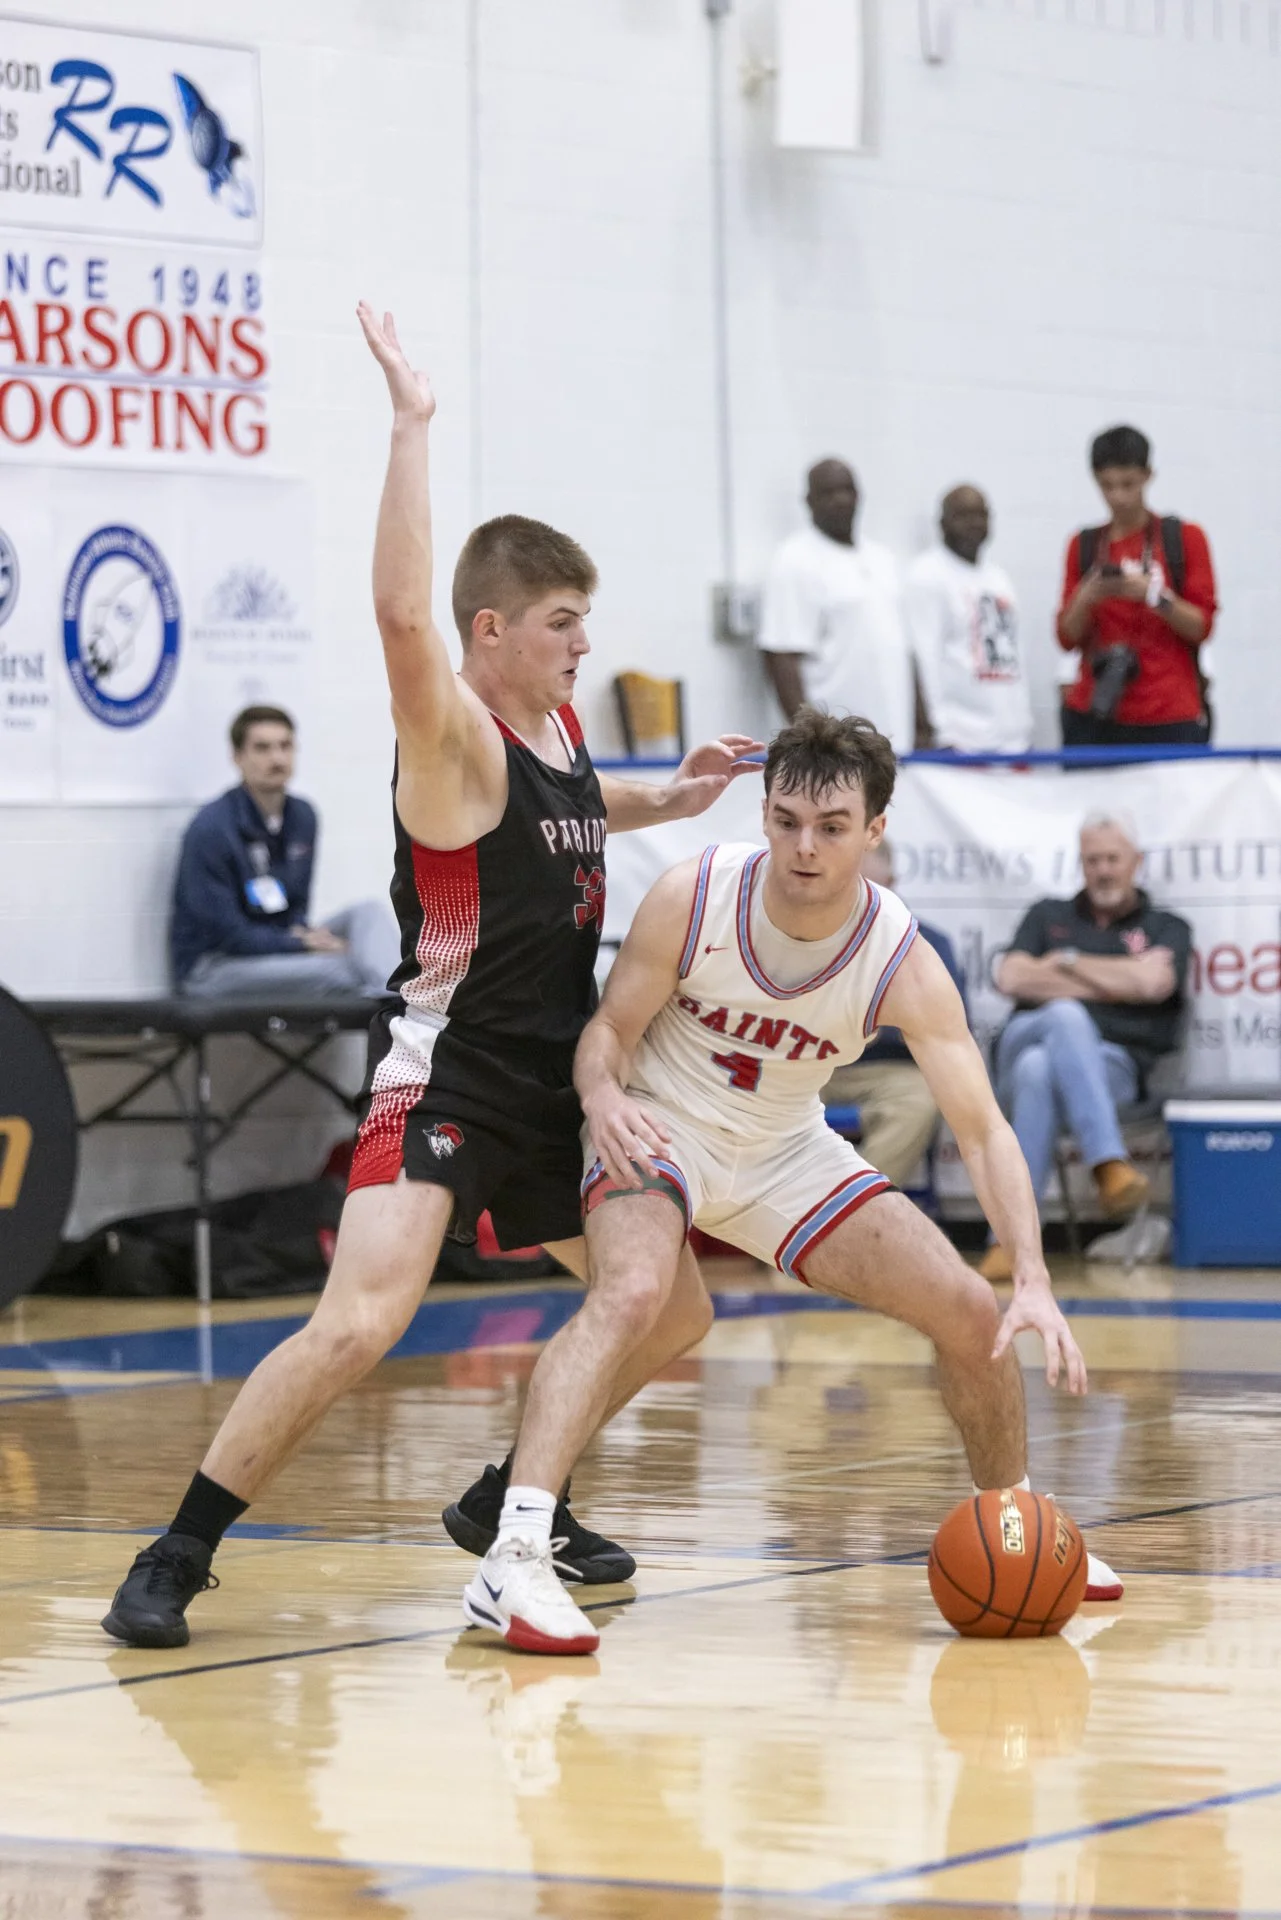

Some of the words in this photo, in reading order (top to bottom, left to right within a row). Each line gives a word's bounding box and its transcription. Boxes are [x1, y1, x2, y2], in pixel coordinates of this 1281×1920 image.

[0, 150, 81, 198] ional
[5, 253, 108, 299] NCE
[152, 265, 262, 312] 1948
